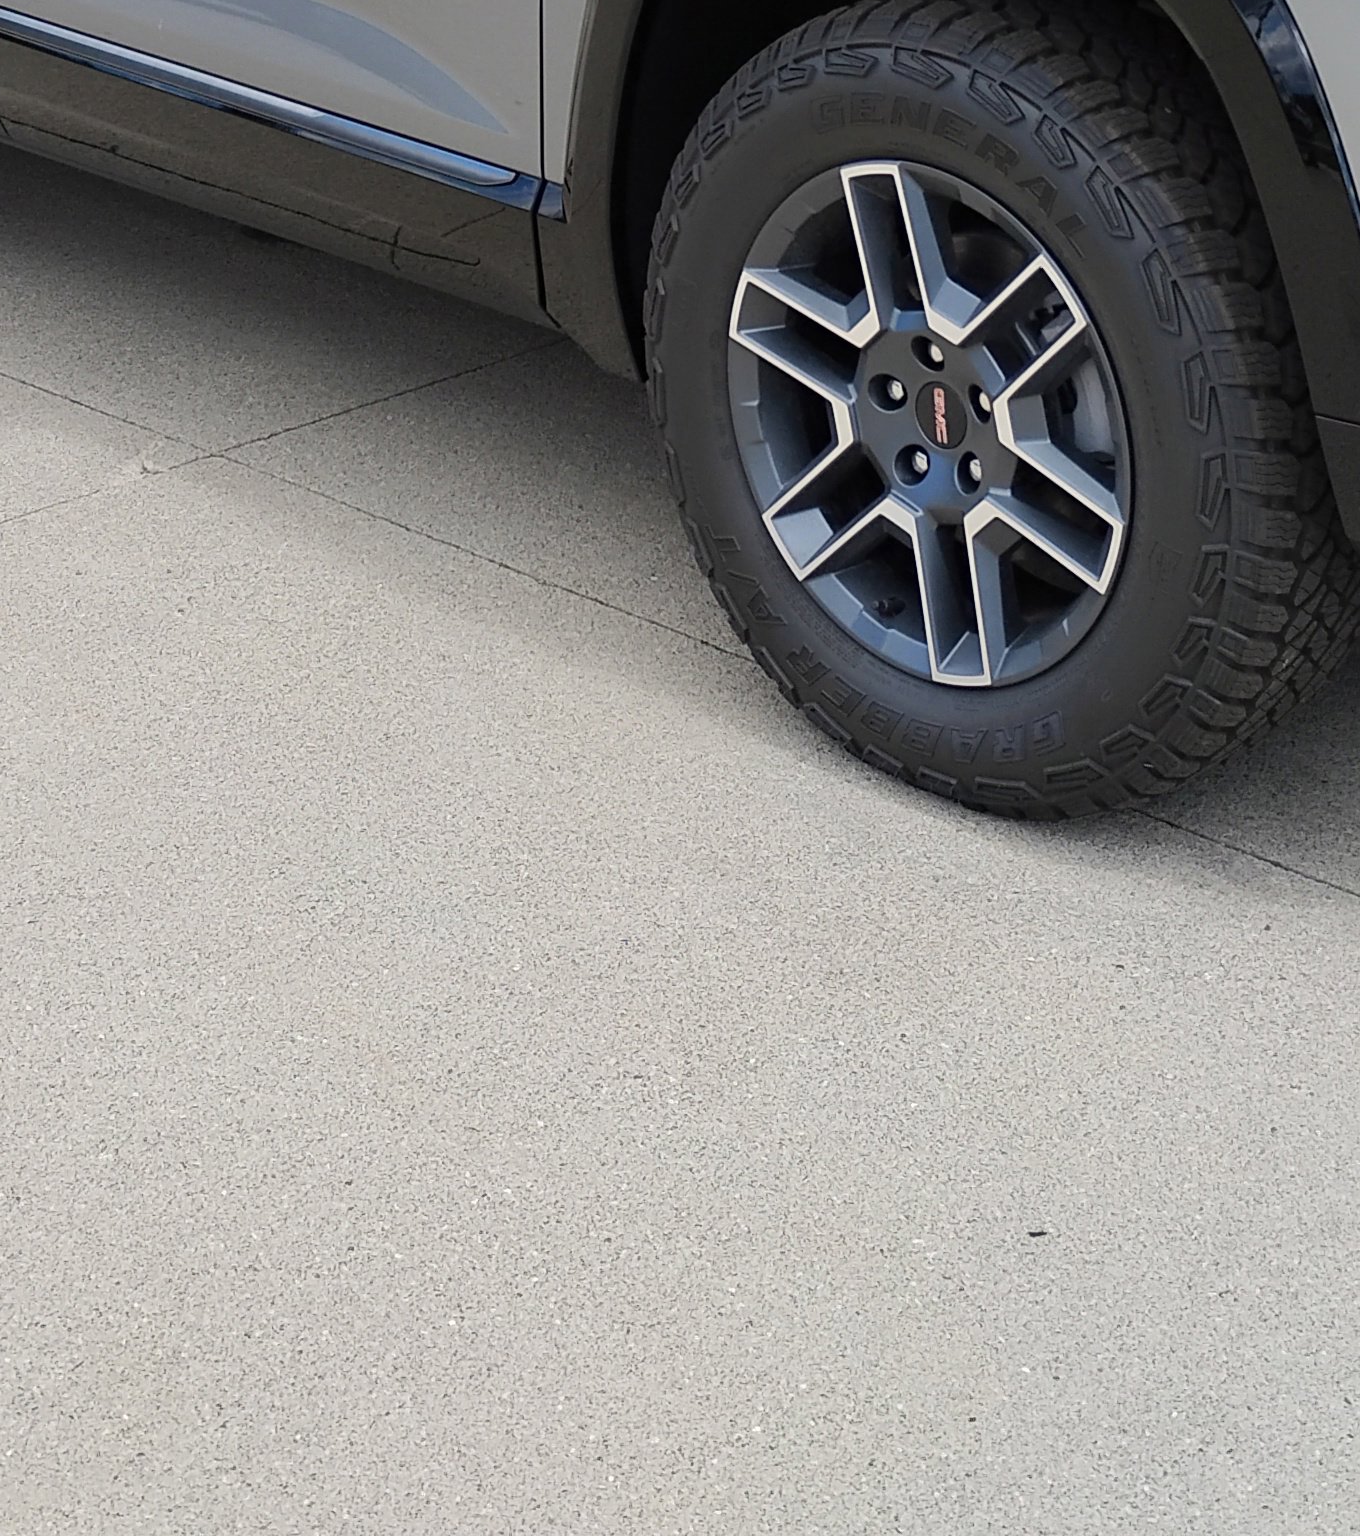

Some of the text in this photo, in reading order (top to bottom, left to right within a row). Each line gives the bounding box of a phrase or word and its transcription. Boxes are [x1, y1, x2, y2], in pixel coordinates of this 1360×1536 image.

[810, 90, 1087, 261] GENERAL
[933, 386, 949, 444] GMC
[787, 643, 1066, 762] GRABBER
